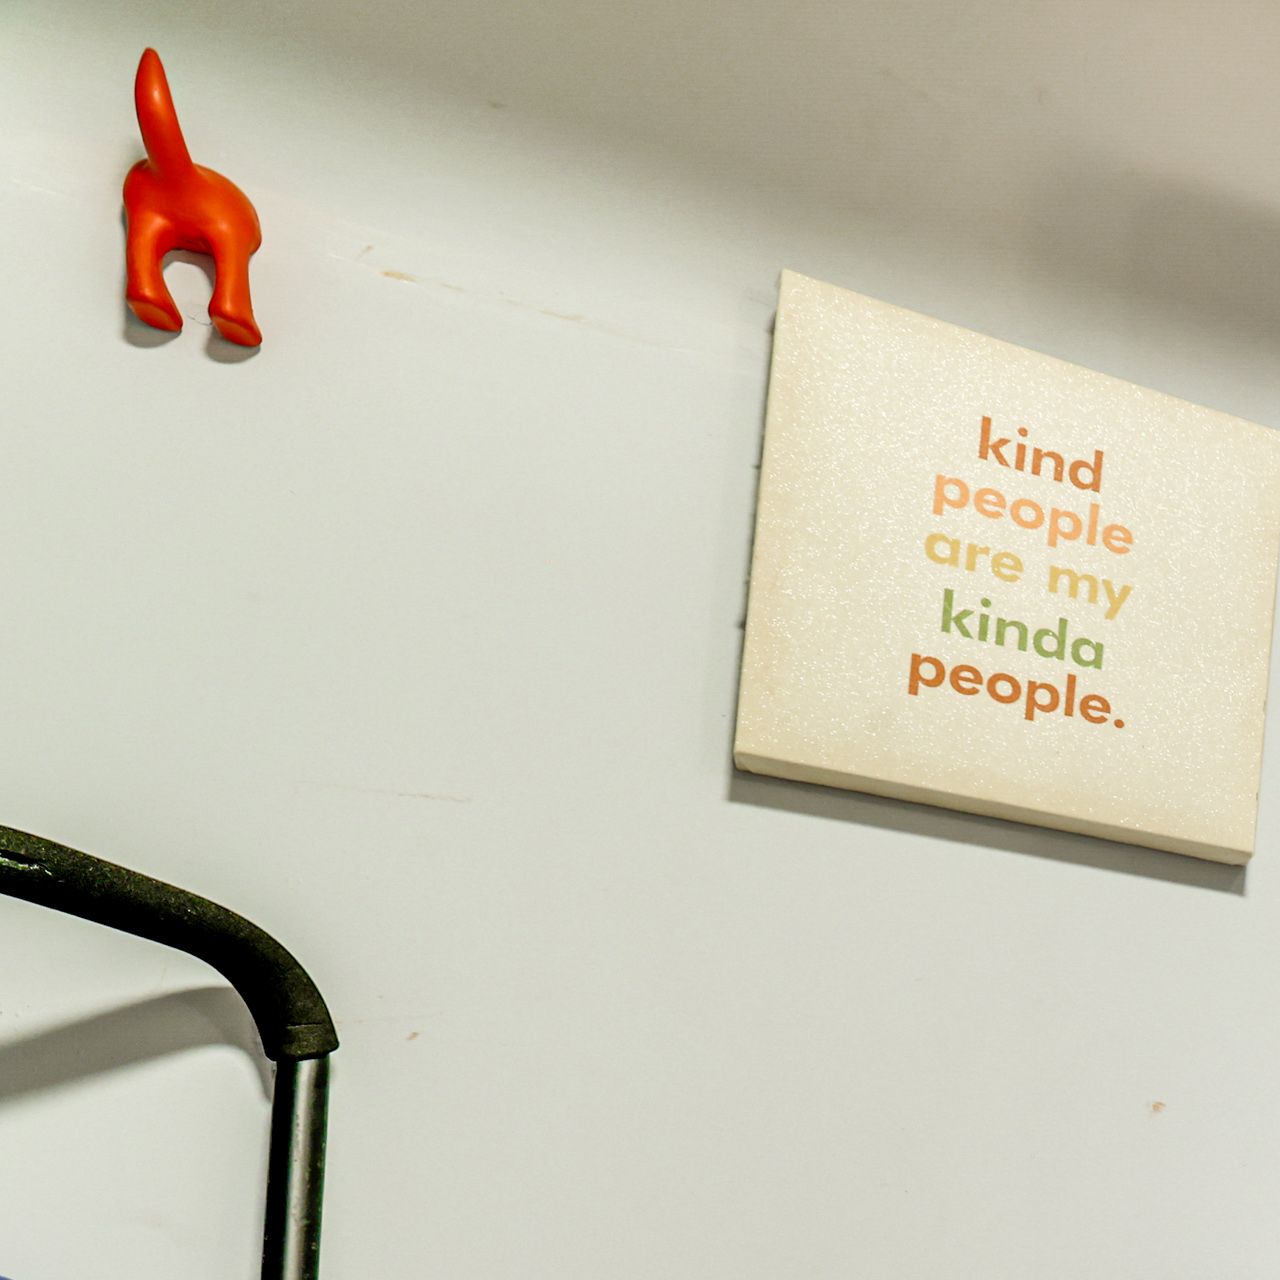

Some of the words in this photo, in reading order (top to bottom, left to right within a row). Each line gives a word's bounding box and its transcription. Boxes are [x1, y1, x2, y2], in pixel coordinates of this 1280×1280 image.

[977, 416, 1105, 493] kind
[931, 473, 1135, 556] people
[923, 532, 1025, 584] are
[1046, 561, 1134, 621] my
[939, 588, 1106, 671] kinda
[907, 652, 1126, 730] people.
